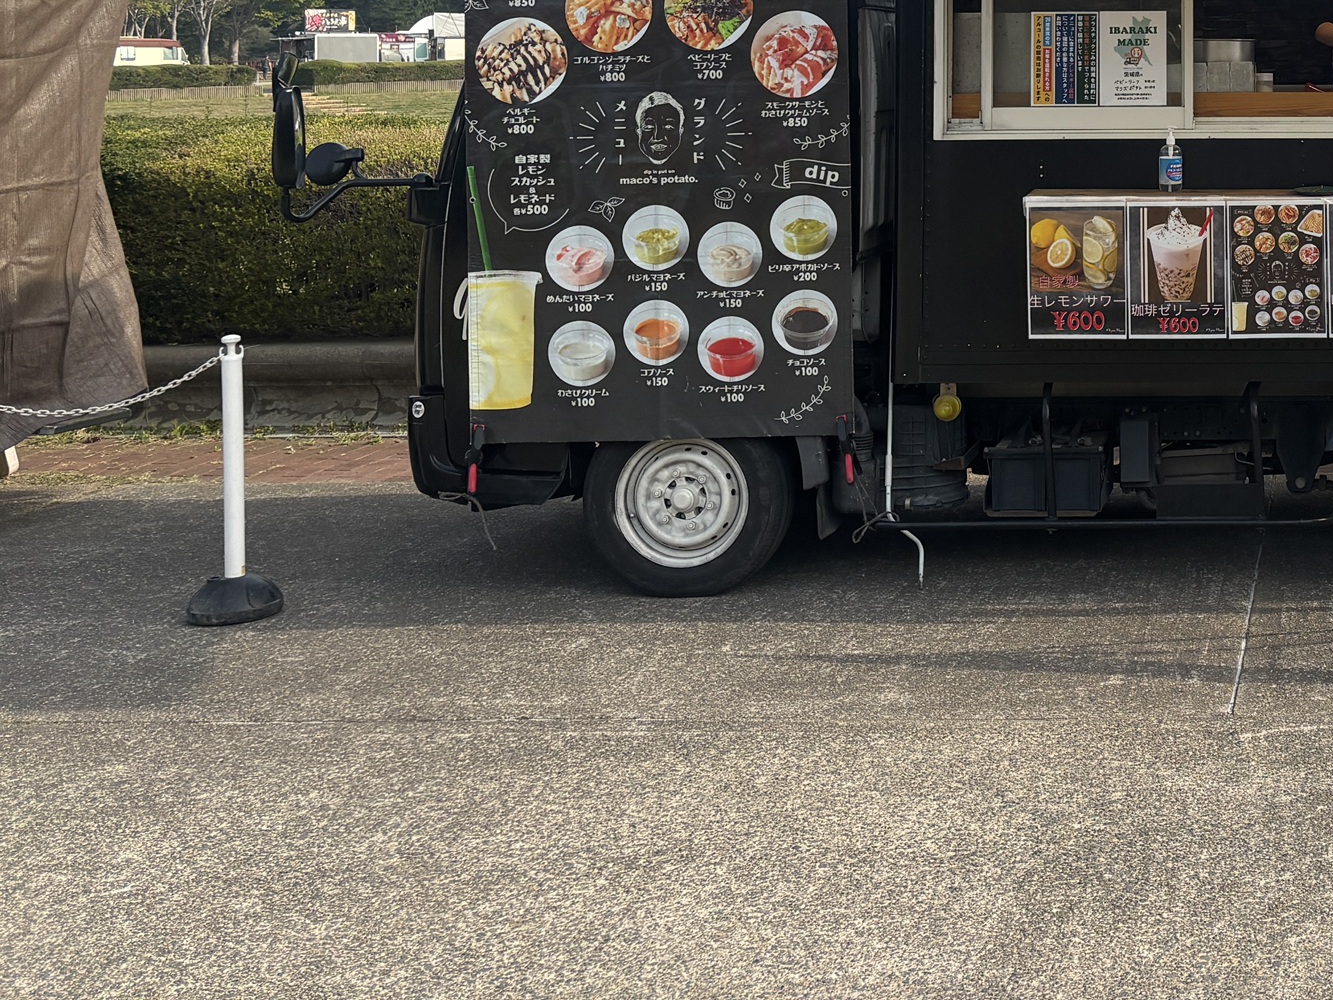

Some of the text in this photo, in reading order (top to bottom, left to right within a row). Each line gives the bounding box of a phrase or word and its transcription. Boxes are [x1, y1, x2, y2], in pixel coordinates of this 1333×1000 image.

[1109, 26, 1158, 35] IBARAKI
[1117, 38, 1150, 47] MADE
[600, 72, 626, 82] ¥800
[697, 70, 723, 79] ¥700
[765, 100, 826, 109] スモークサーモンと
[506, 108, 536, 116] ベルギー
[760, 109, 830, 118] わさびクリームソース
[501, 116, 541, 124] チョコレート
[782, 118, 808, 128] ¥850
[507, 125, 535, 134] ¥800
[613, 100, 627, 166] メニュー
[693, 98, 706, 165] グランド
[514, 154, 551, 164] 自家製
[518, 165, 547, 175] レモン
[619, 175, 698, 186] maco's potato.
[804, 164, 839, 187] dip
[510, 177, 555, 186] スカッシュ
[510, 194, 555, 204] レモネード
[513, 205, 549, 215] 各¥500
[627, 273, 686, 282] バジルマヨネーズ
[793, 272, 818, 282] ¥200
[1038, 275, 1079, 289] 自家製
[645, 282, 668, 292] ¥150
[546, 293, 615, 303] めんたいマヨネーズ
[696, 289, 765, 299] アンチョビマヨネーズ
[719, 298, 743, 309] ¥150
[1029, 294, 1126, 308] 生レモンサワー
[568, 303, 593, 313] ¥100
[1131, 303, 1225, 317] 珈琲ゼリーラテ
[1050, 310, 1106, 332] ¥600
[1156, 316, 1200, 334] ¥600
[786, 358, 827, 367] チョコソース
[794, 367, 819, 377] ¥100
[646, 377, 669, 387] ¥150
[557, 388, 610, 398] わさびクリーム
[720, 393, 745, 403] ¥100
[571, 397, 596, 408] ¥100
